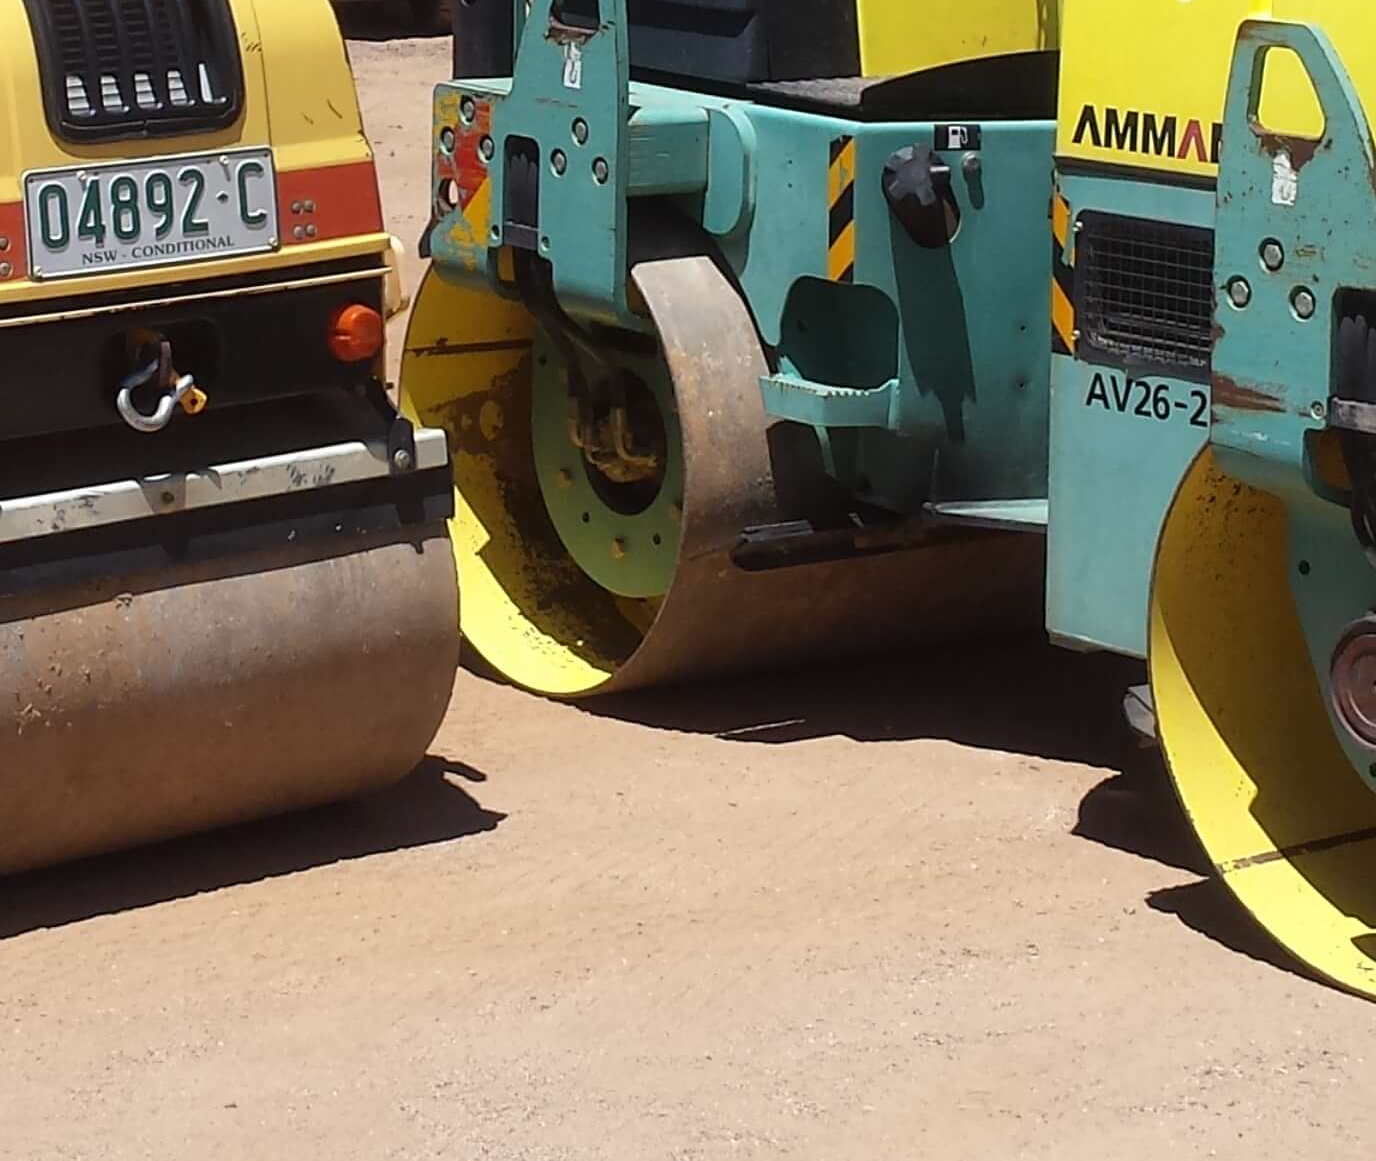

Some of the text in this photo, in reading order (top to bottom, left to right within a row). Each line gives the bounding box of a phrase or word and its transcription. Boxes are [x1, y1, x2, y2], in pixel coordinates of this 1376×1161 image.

[81, 236, 235, 265] NSW CONDITIONAL
[1085, 372, 1209, 429] AV26-2
